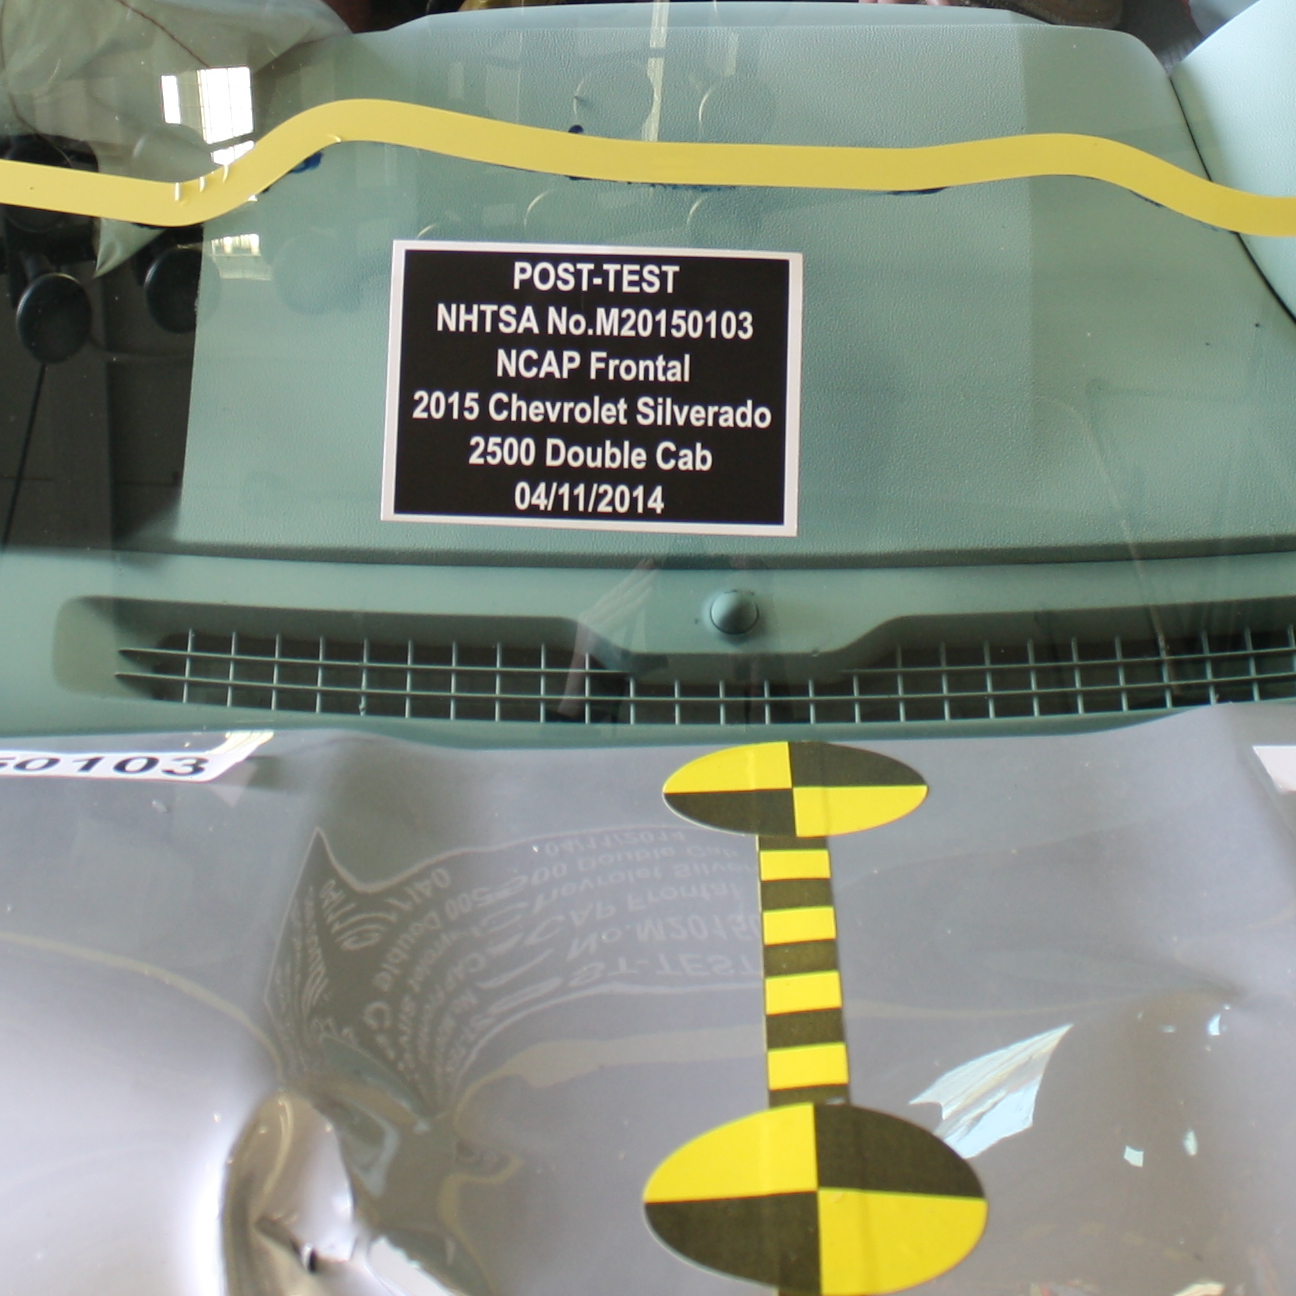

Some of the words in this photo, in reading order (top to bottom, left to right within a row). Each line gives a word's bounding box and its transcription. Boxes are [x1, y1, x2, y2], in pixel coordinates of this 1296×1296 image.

[512, 261, 681, 294] POST-TEST
[435, 302, 540, 335] NHTSA
[547, 307, 755, 340] No.M20150103
[495, 348, 582, 380] NCAP
[589, 351, 691, 383] Frontal
[411, 390, 480, 421] 2015
[488, 392, 628, 426] Chevrolet
[635, 396, 773, 429] Silverado
[468, 436, 536, 466] 2500
[545, 438, 648, 470] Double
[655, 441, 714, 472] Cab
[513, 480, 665, 515] 04/11/2014
